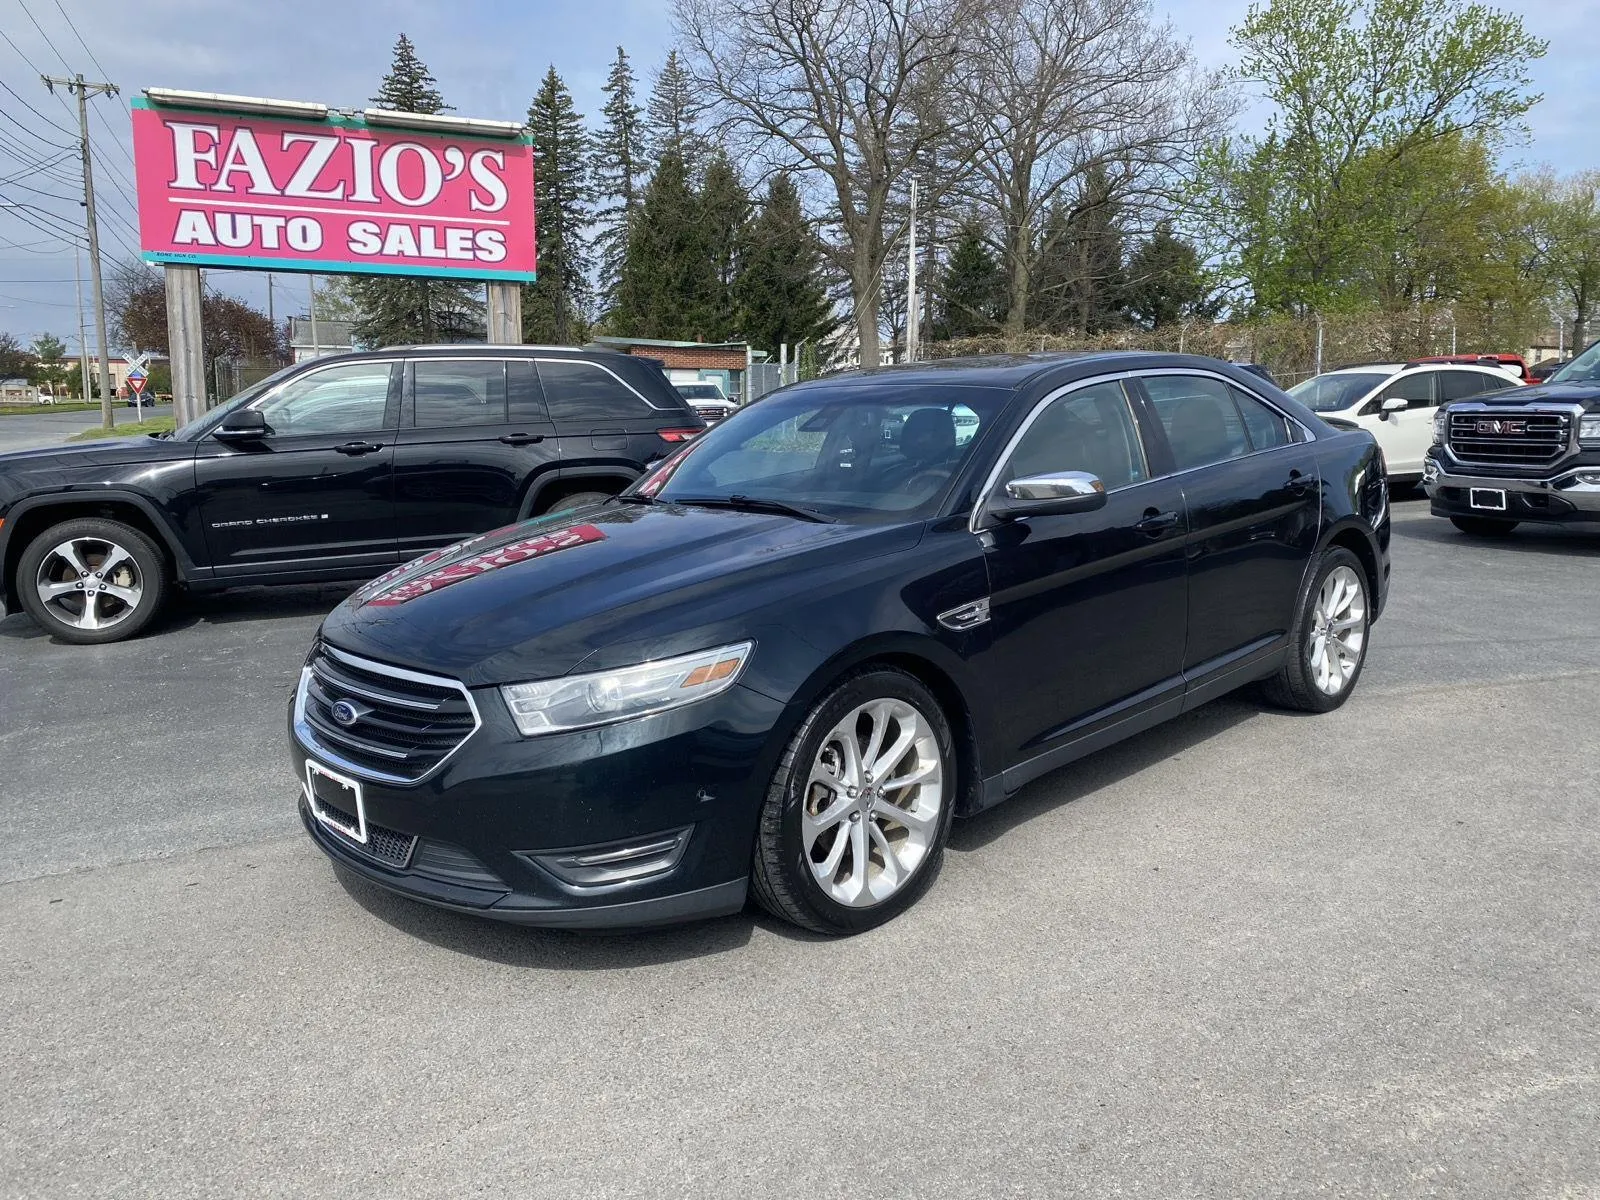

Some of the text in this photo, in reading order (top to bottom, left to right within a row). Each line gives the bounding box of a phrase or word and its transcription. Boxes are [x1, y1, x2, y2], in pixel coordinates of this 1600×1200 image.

[165, 121, 509, 212] FAZIO'S
[172, 209, 508, 262] AUTO SALES
[1477, 420, 1527, 435] GMC
[211, 520, 254, 529] GRAND
[256, 514, 319, 524] CHEROKEE
